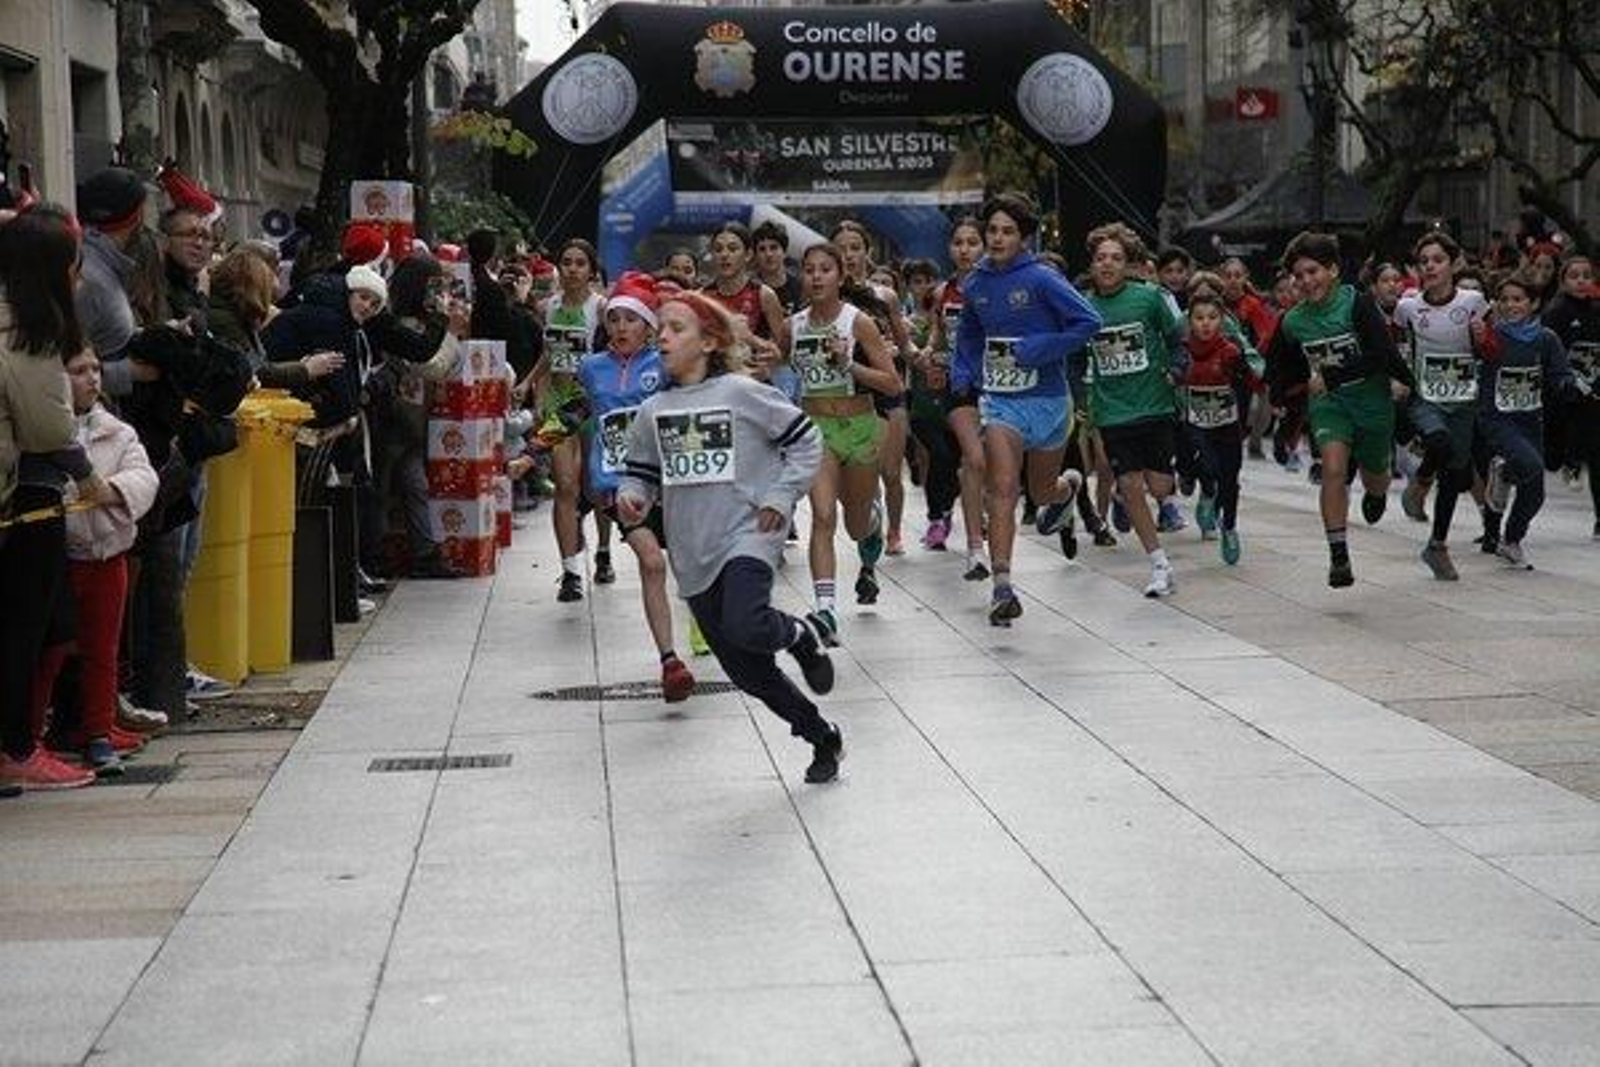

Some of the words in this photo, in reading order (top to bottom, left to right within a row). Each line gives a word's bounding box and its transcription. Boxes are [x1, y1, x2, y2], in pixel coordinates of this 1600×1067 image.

[784, 21, 897, 43] Concello
[905, 21, 937, 43] de
[783, 50, 964, 81] OURENSE
[780, 136, 830, 157] SAN
[664, 451, 729, 477] 3089
